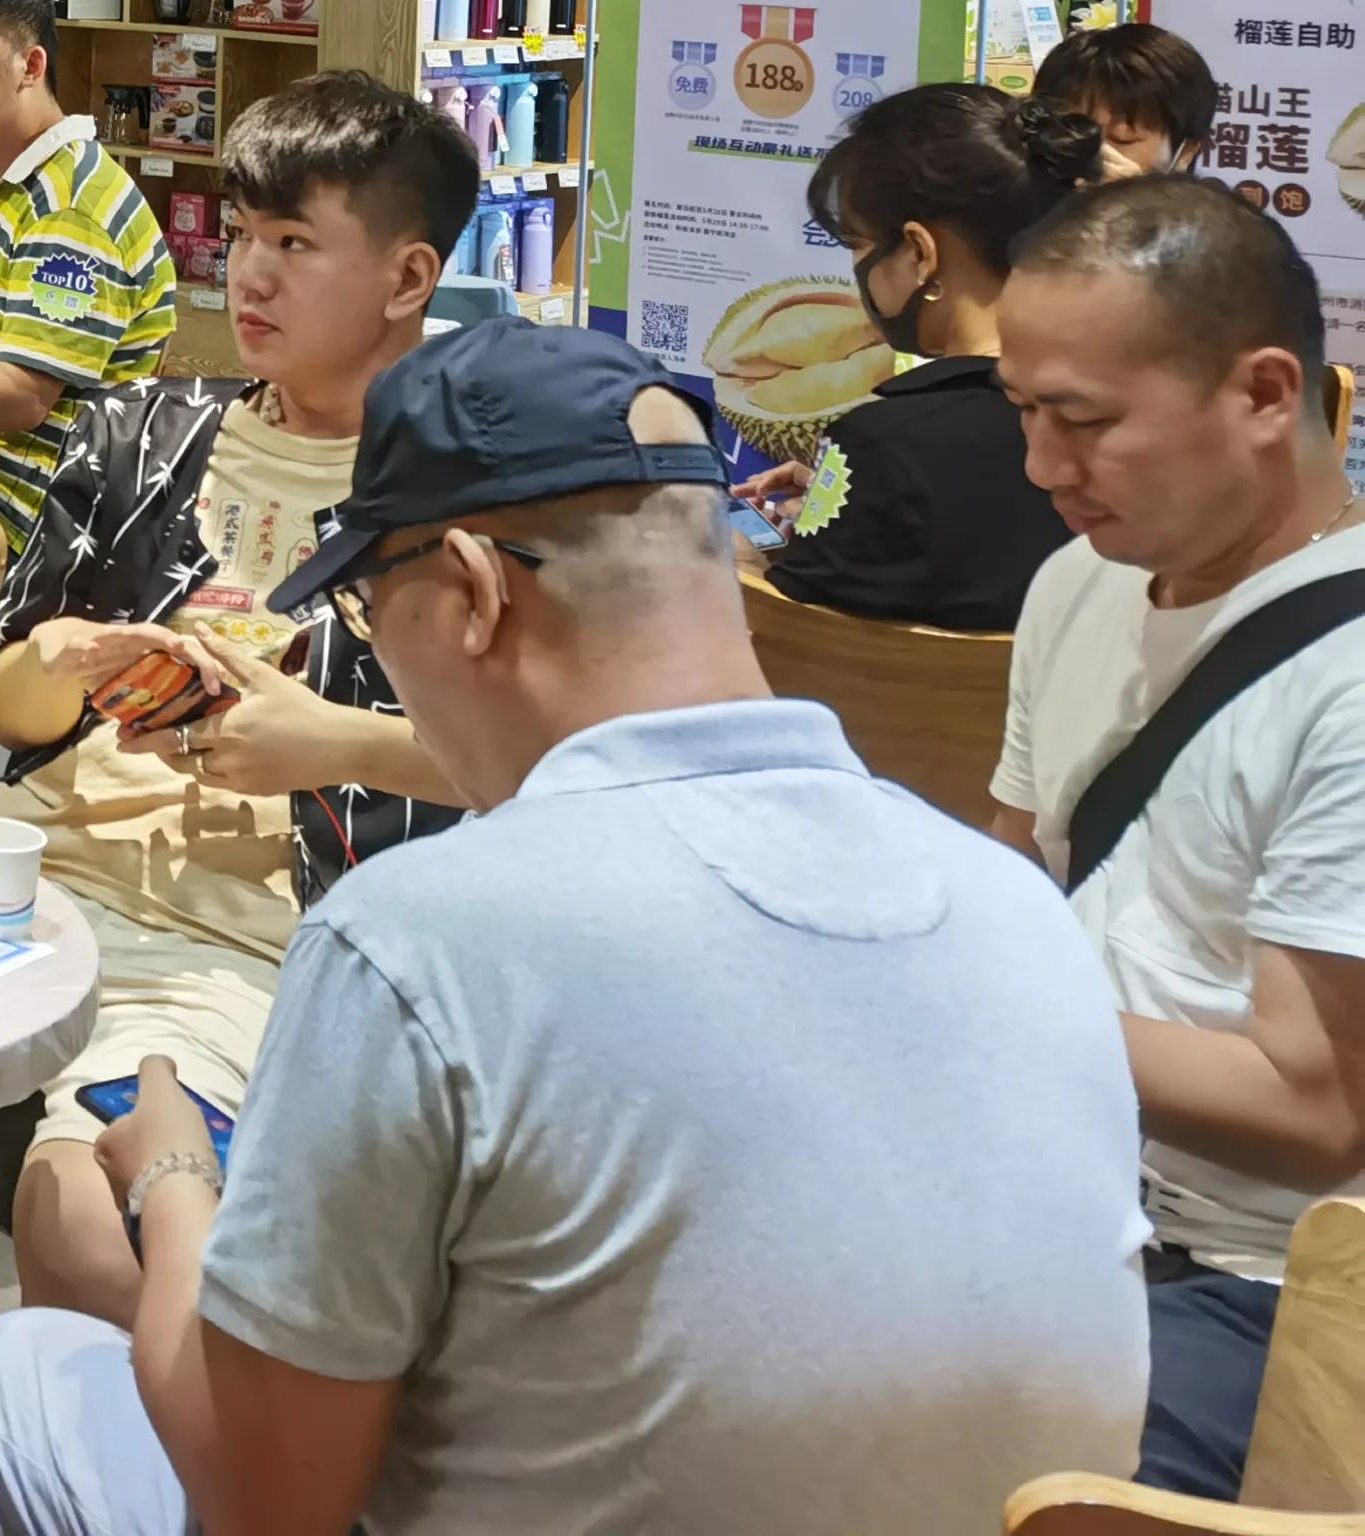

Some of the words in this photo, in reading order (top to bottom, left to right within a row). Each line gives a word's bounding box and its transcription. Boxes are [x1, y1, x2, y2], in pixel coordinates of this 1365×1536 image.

[1234, 18, 1357, 50] 榴莲自助
[675, 76, 709, 95] 免费
[839, 91, 873, 108] 208
[1199, 122, 1311, 174] 榴莲
[41, 271, 88, 291] TOP10
